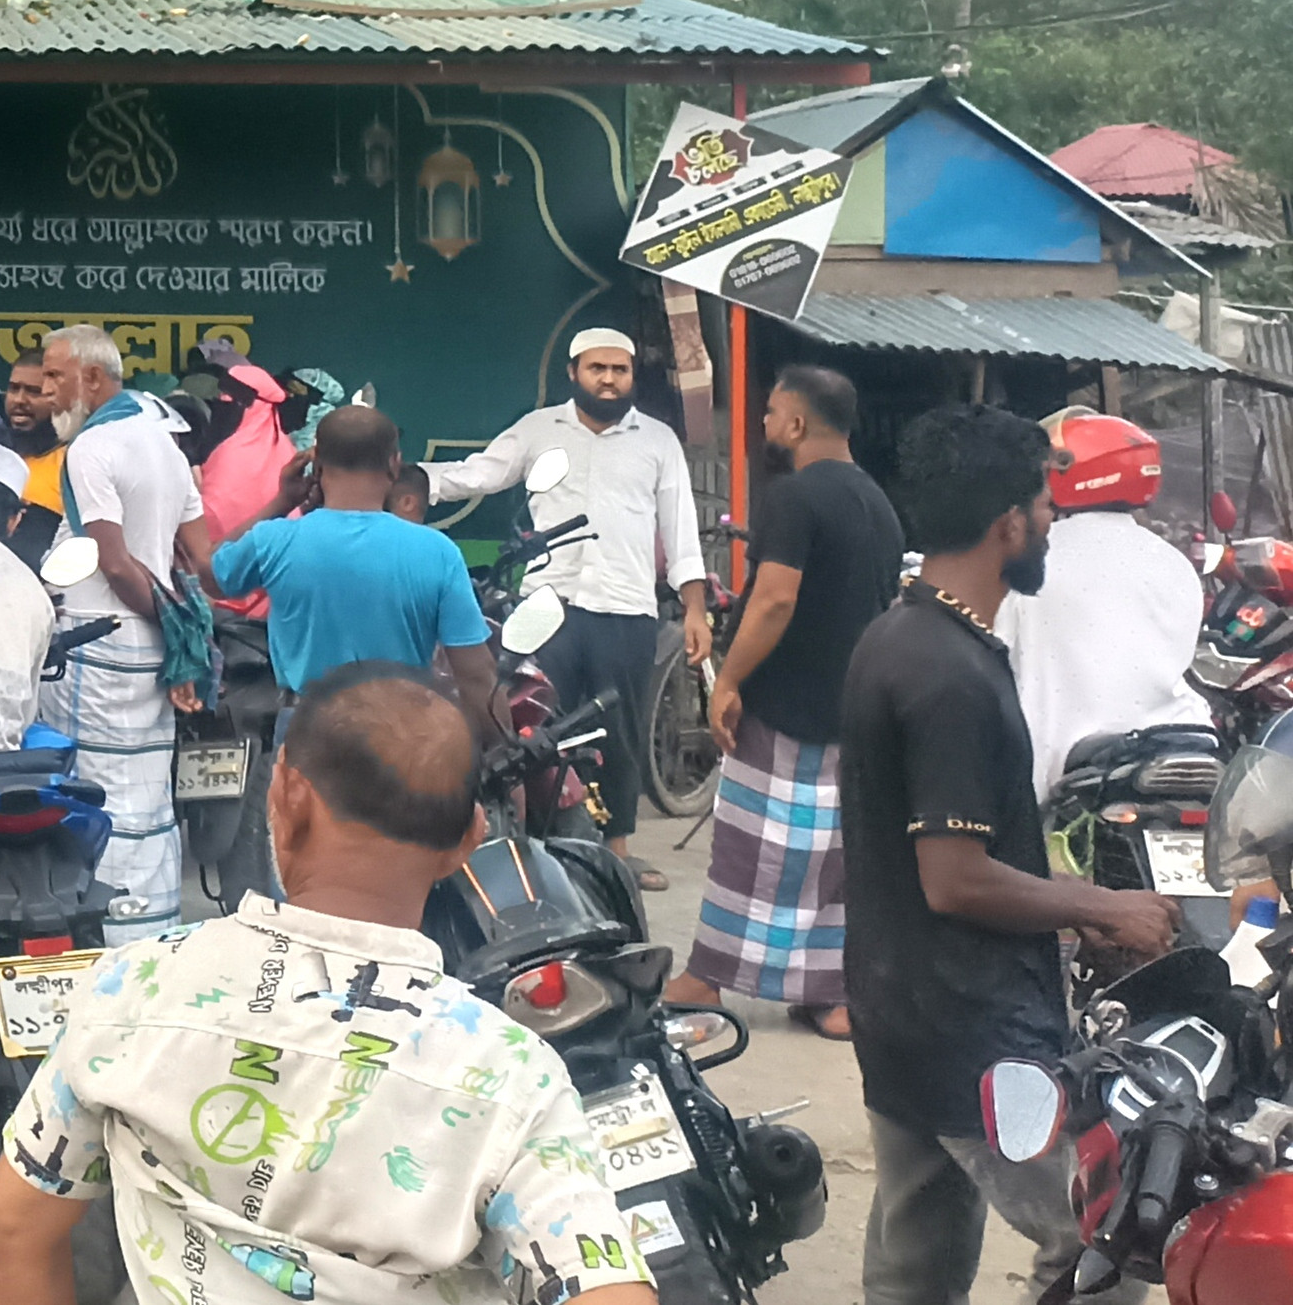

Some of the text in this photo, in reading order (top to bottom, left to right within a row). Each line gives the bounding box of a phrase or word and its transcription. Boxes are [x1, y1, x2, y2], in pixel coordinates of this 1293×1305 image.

[32, 217, 78, 245] ধরে
[74, 265, 128, 293] করে
[136, 266, 232, 295] দেওয়ার
[239, 261, 327, 293] মালিক
